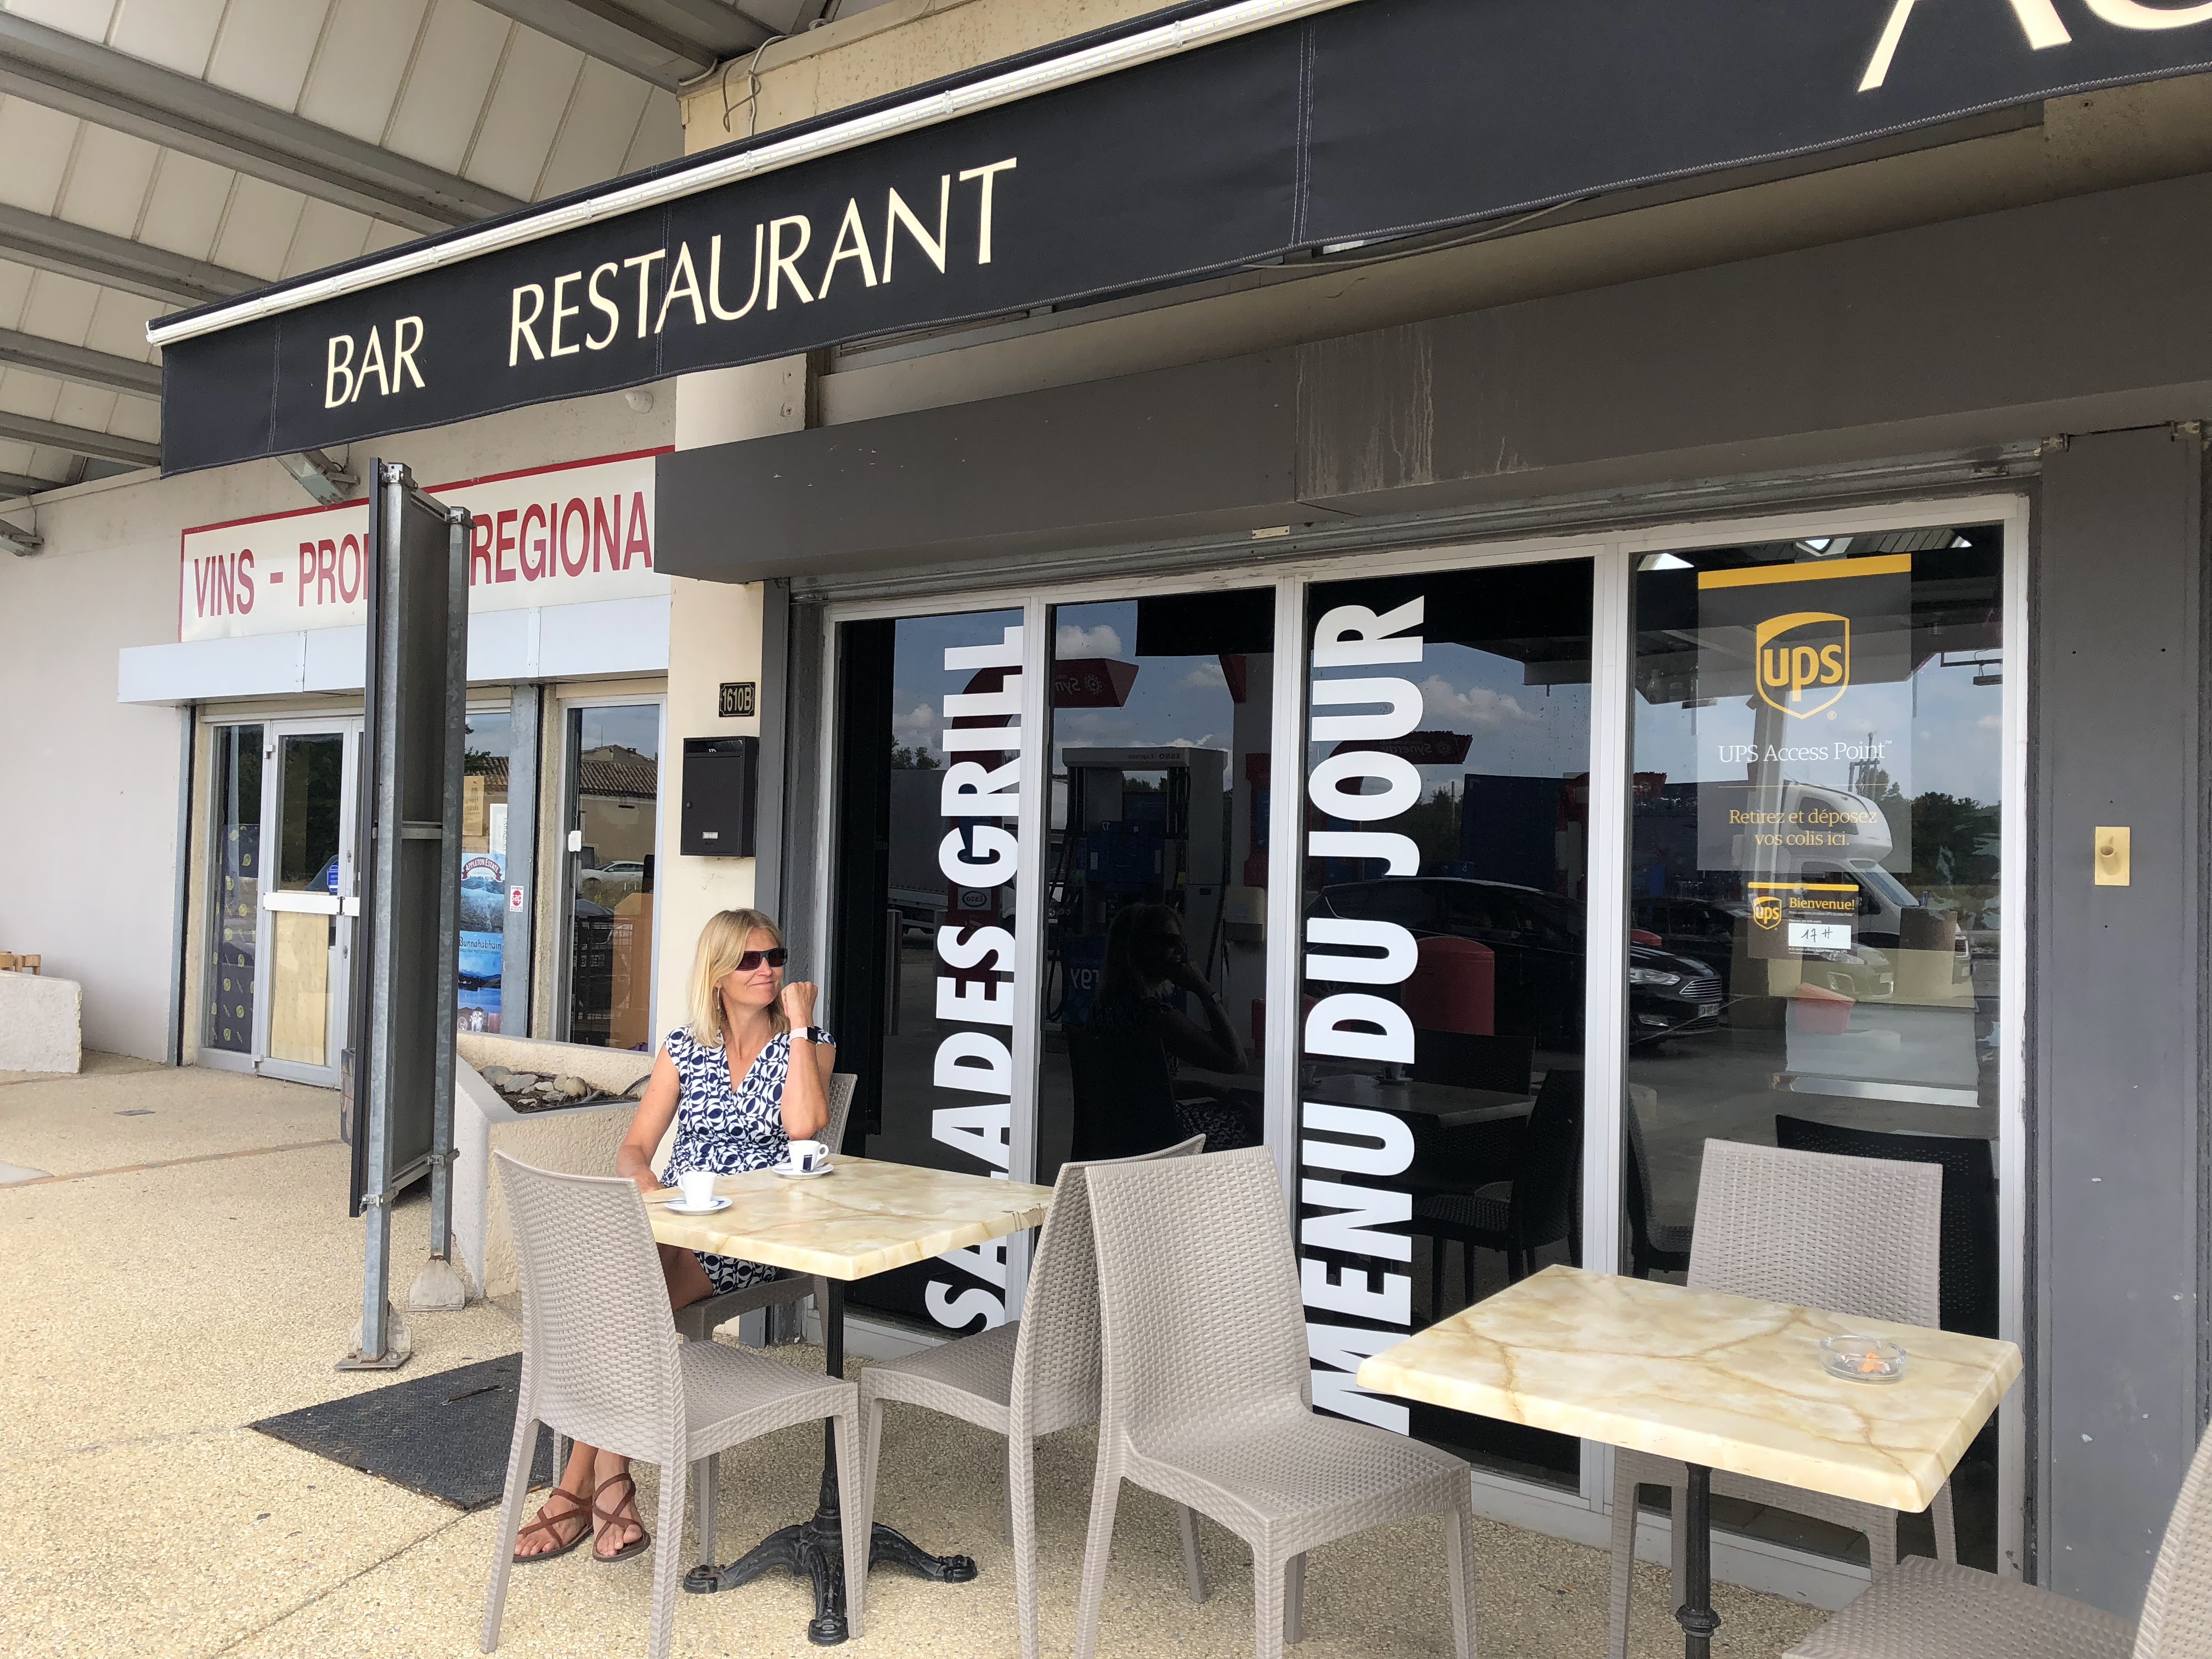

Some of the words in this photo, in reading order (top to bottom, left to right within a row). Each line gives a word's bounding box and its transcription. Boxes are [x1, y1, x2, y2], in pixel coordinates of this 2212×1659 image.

[324, 315, 426, 409] BAR
[508, 157, 1017, 366] RESTAURANT
[194, 548, 255, 618] VINS
[298, 533, 368, 607] PRO
[1763, 644, 1843, 702] ups
[723, 687, 752, 712] 1610B
[938, 625, 1024, 888] GRILL
[1308, 595, 1425, 877] JOUR
[1718, 744, 1759, 763] UPS
[1763, 744, 1829, 762] Access
[1729, 809, 1785, 824] Retirez
[1788, 810, 1804, 824] et
[1808, 808, 1877, 828] déposez
[1754, 834, 1783, 846] vos
[1786, 830, 1824, 846] colis
[1827, 830, 1850, 846] ici.
[465, 858, 485, 872] APPLETON
[485, 858, 500, 873] ESTATE
[511, 894, 522, 904] sap
[1788, 897, 1855, 910] Bienvenue!
[459, 936, 501, 950] Bunnahabhain
[1304, 917, 1418, 1064] DU
[925, 926, 1016, 1333] SAADES
[1301, 1102, 1414, 1437] MENU
